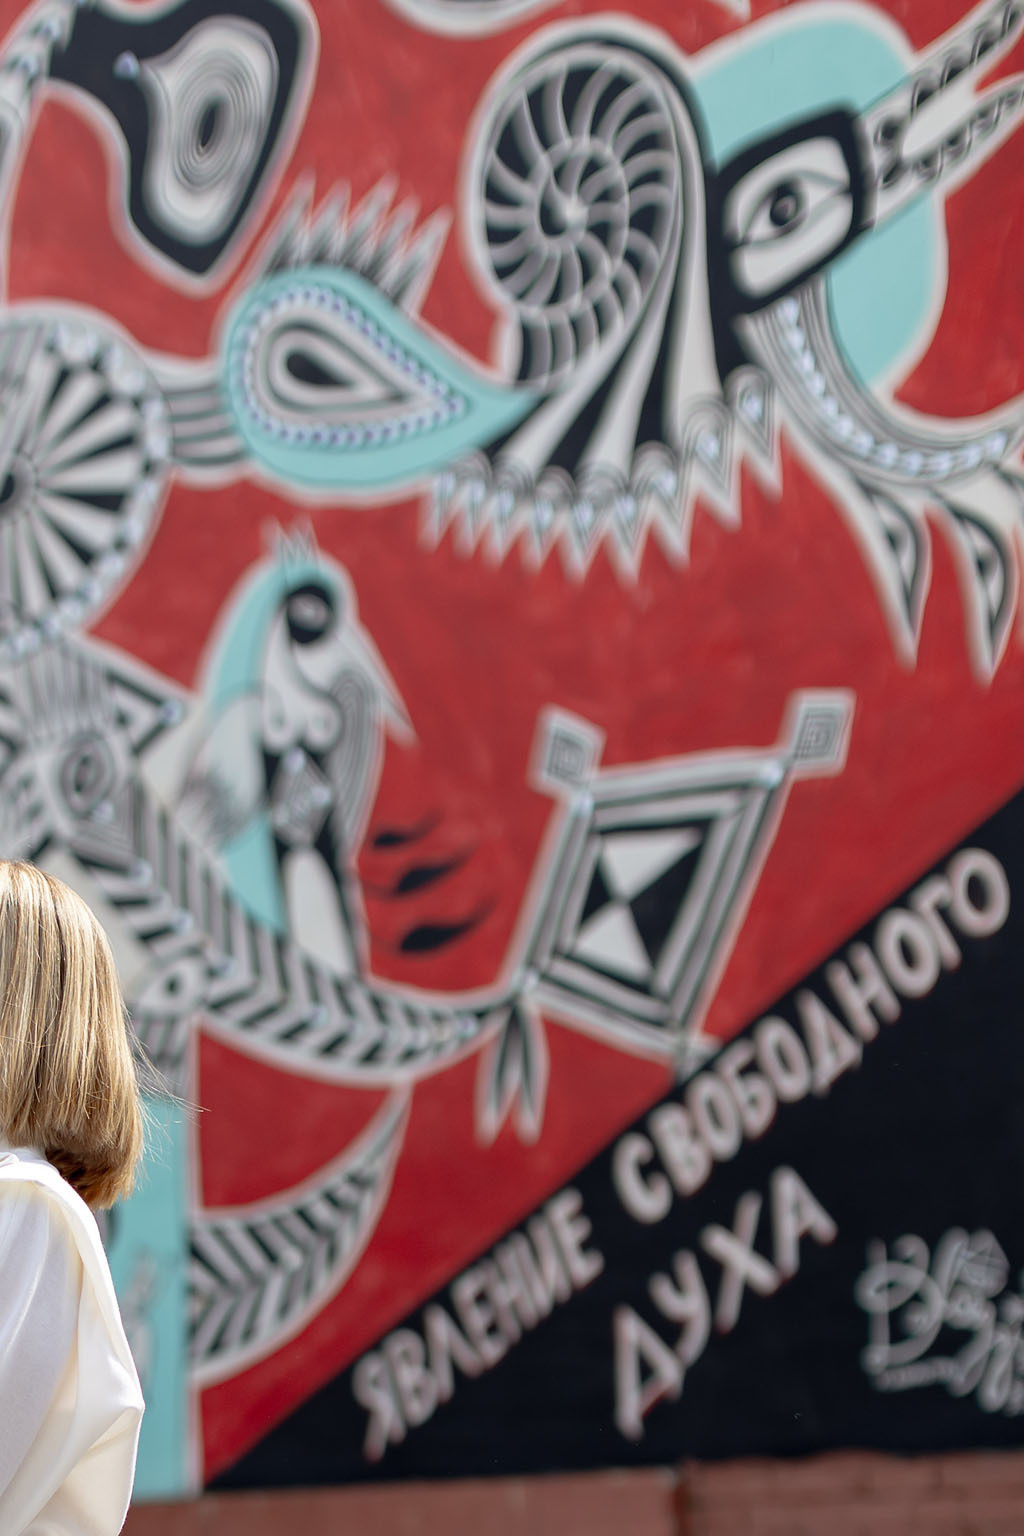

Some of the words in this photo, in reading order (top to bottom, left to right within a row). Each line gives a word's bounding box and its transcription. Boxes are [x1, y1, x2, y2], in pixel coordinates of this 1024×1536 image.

[352, 1190, 604, 1462] ЯВЛЕНИЕ
[613, 847, 1010, 1225] СВОБОДНОГО
[615, 1165, 837, 1440] ДУХА
